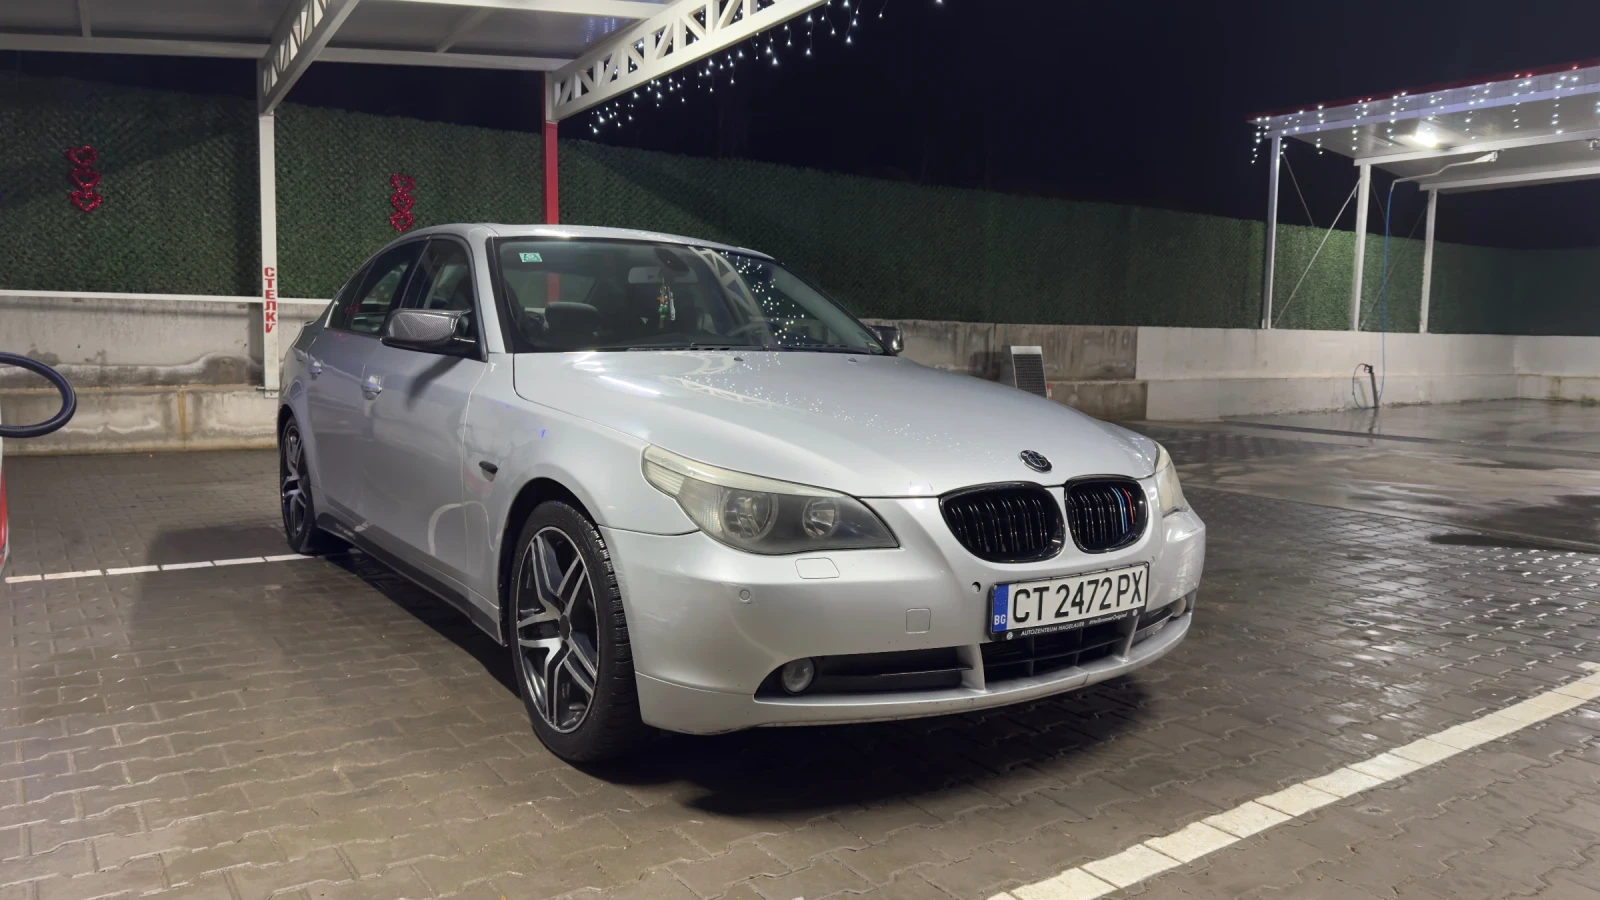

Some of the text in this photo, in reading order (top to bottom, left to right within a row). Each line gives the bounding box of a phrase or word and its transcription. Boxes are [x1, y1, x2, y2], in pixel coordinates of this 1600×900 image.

[1013, 570, 1143, 623] CT 2472 PX
[994, 614, 1006, 625] BG
[1020, 625, 1058, 636] AUTOZENTRUM
